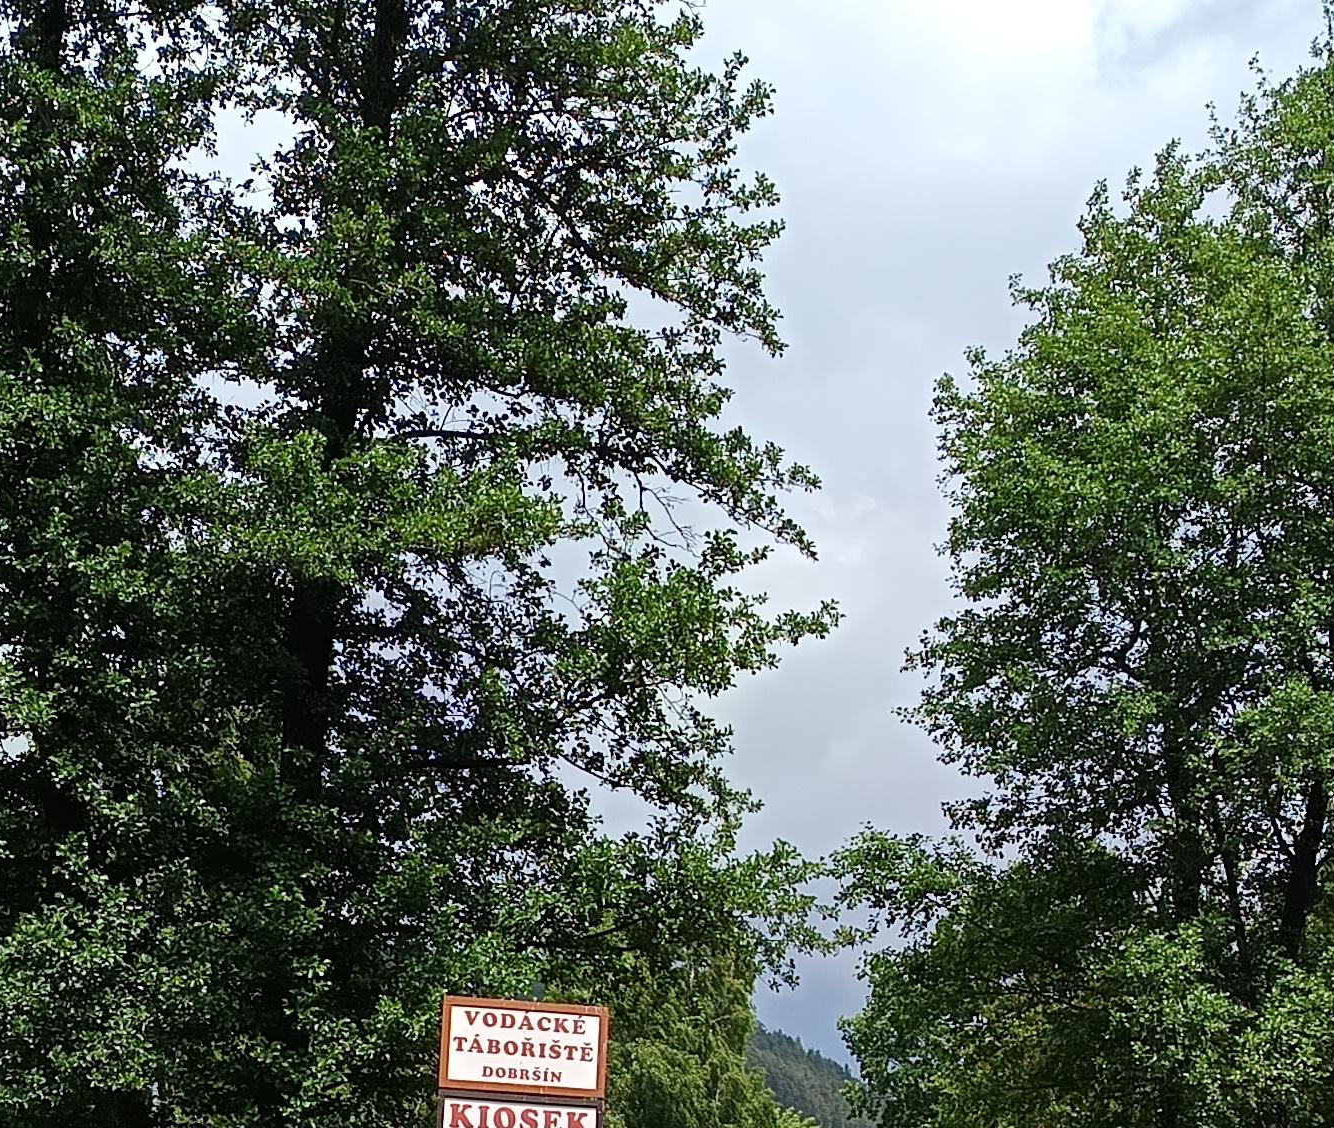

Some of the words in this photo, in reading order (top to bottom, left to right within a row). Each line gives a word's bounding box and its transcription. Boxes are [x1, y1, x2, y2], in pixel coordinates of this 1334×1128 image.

[464, 1010, 586, 1035] VODÁCKÉ
[453, 1034, 594, 1063] TÁBOŘIŠTĚ
[482, 1066, 563, 1083] DOBRŠÍN
